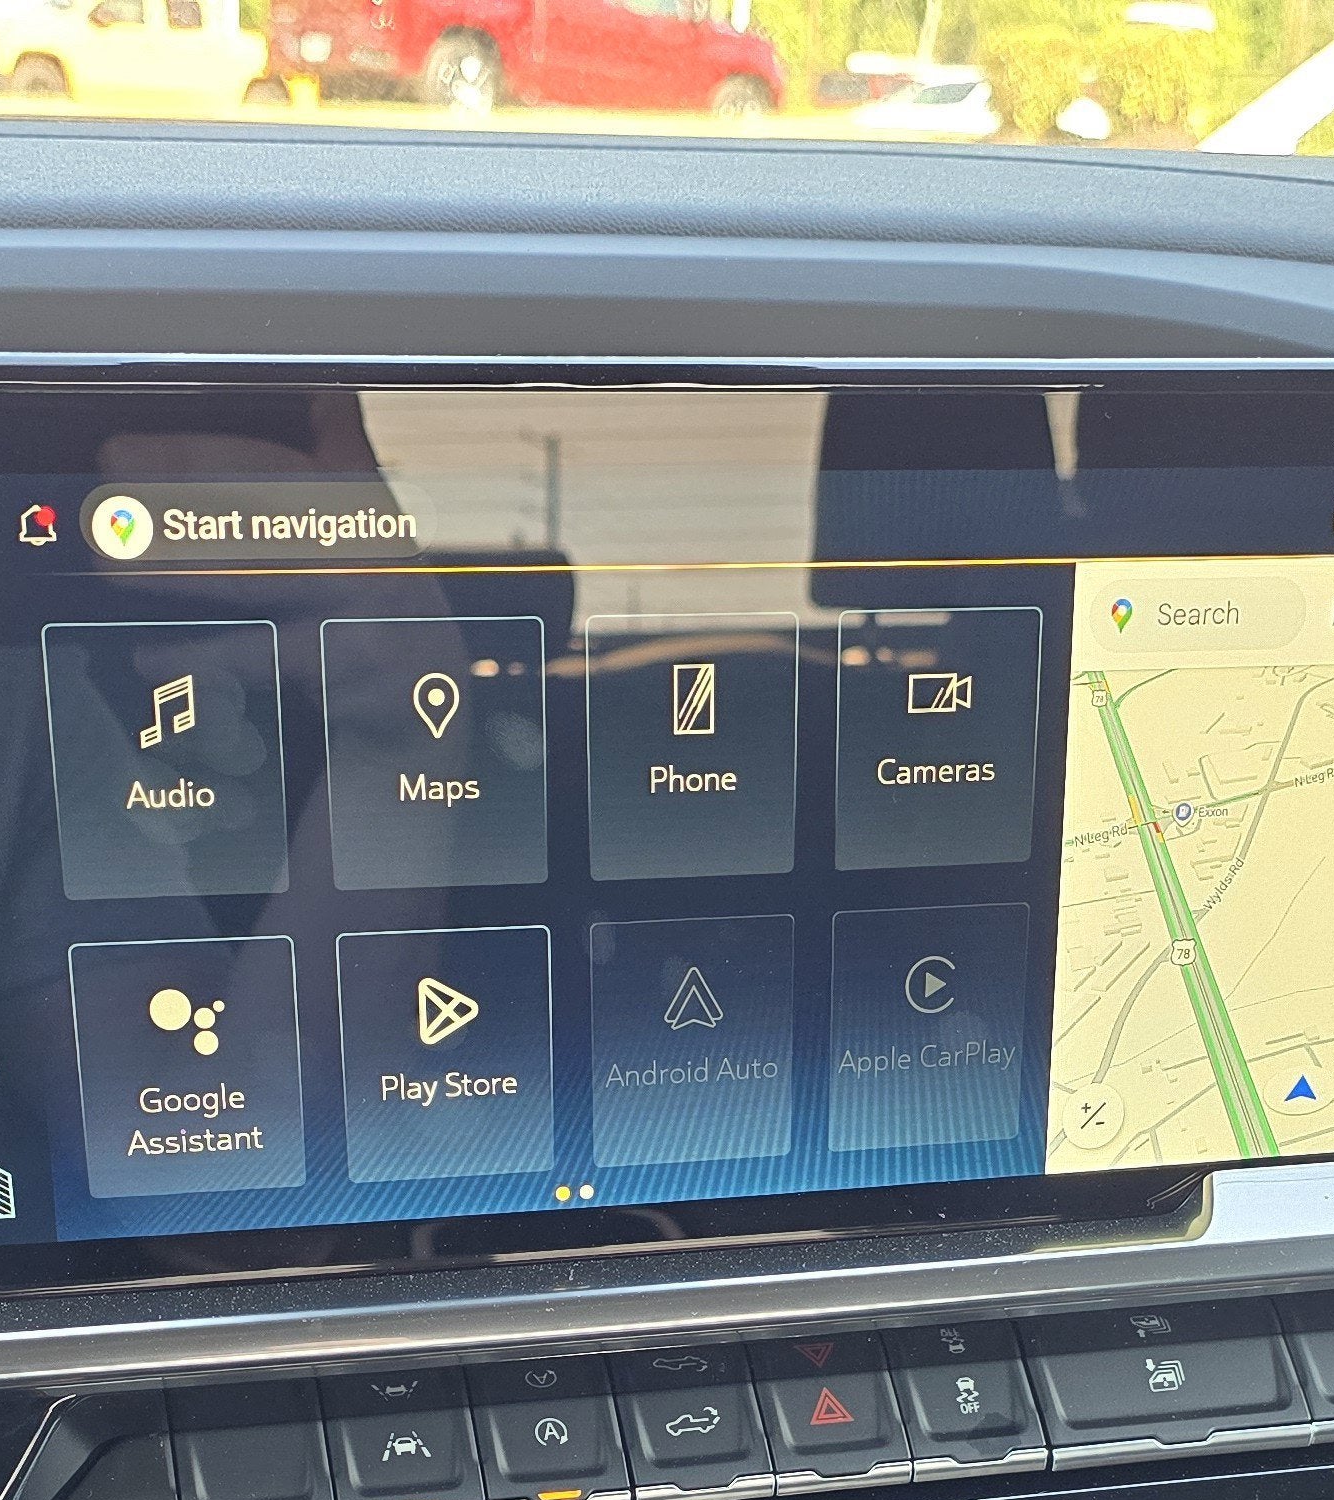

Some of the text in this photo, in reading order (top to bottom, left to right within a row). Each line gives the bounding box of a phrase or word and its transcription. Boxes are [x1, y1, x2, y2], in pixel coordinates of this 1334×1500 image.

[162, 506, 417, 547] Start navigation
[1156, 600, 1240, 628] Search
[648, 764, 738, 794] Phone
[876, 758, 995, 786] Cameras
[1294, 776, 1304, 788] N
[1305, 771, 1326, 785] Leg
[125, 778, 215, 810] Audio
[398, 773, 480, 807] Maps
[1197, 806, 1229, 818] Exxon
[1074, 822, 1128, 848] N Leg Rd
[1202, 857, 1245, 910] Wylds Rd
[1176, 948, 1191, 960] 78
[605, 1057, 779, 1089] Android Auto
[838, 1039, 1016, 1078] Apple CarPlay
[137, 1083, 246, 1119] Google
[380, 1071, 518, 1107] Play Store
[126, 1126, 264, 1157] Assistant
[959, 1401, 981, 1415] OFF
